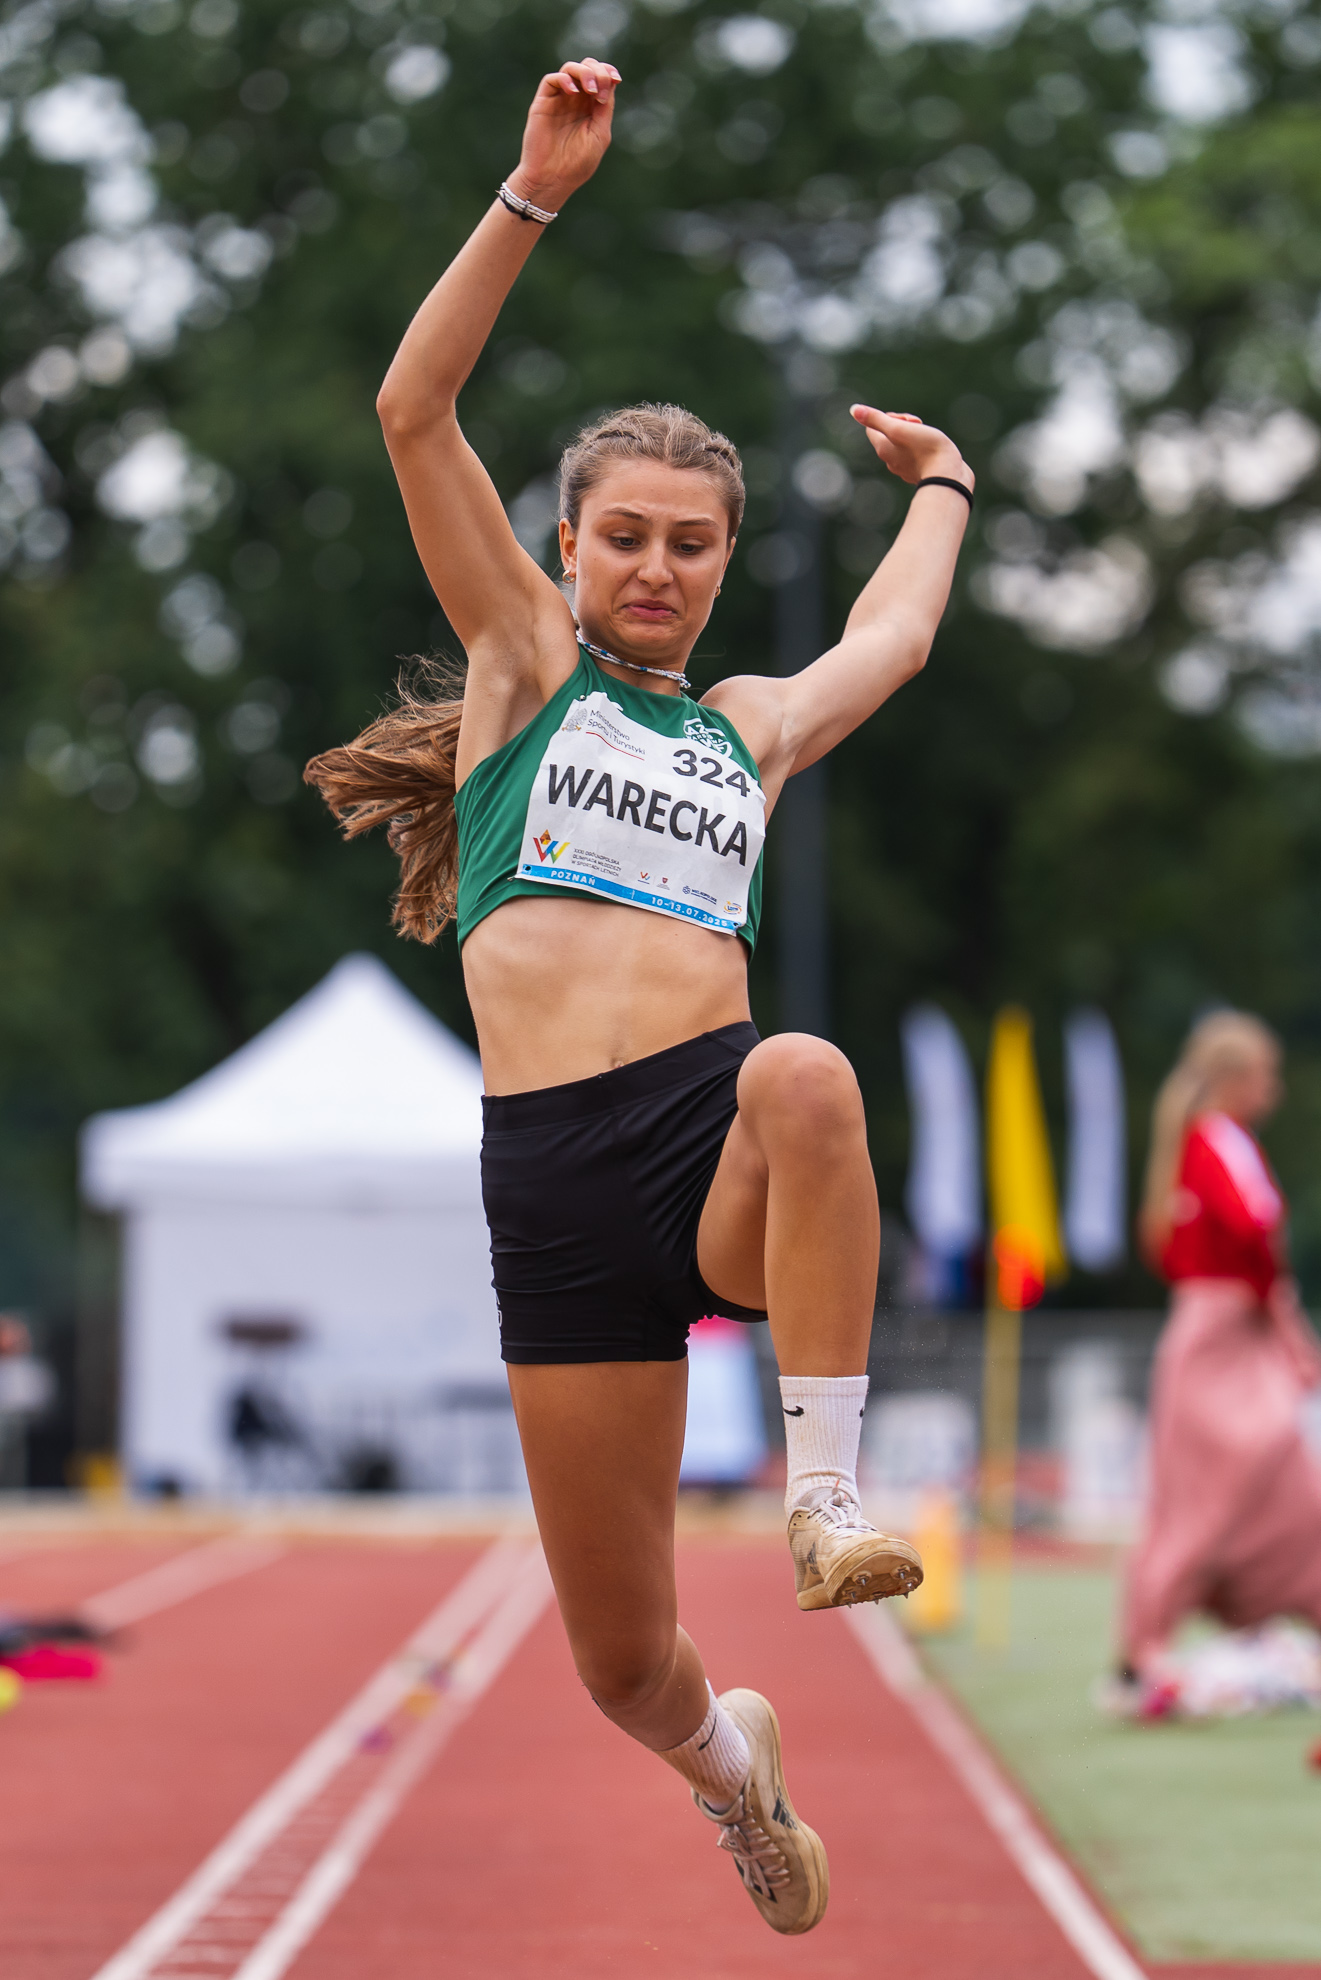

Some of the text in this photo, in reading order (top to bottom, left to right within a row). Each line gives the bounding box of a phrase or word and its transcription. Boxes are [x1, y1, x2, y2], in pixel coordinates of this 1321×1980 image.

[587, 718, 609, 736] Sportu
[613, 734, 646, 755] Turystyki
[590, 709, 630, 741] Ministerstwo
[672, 749, 751, 798] 324
[548, 763, 748, 867] WARECKA
[550, 870, 596, 886] POZNAŃ
[651, 896, 728, 927] 10-13.07.2025
